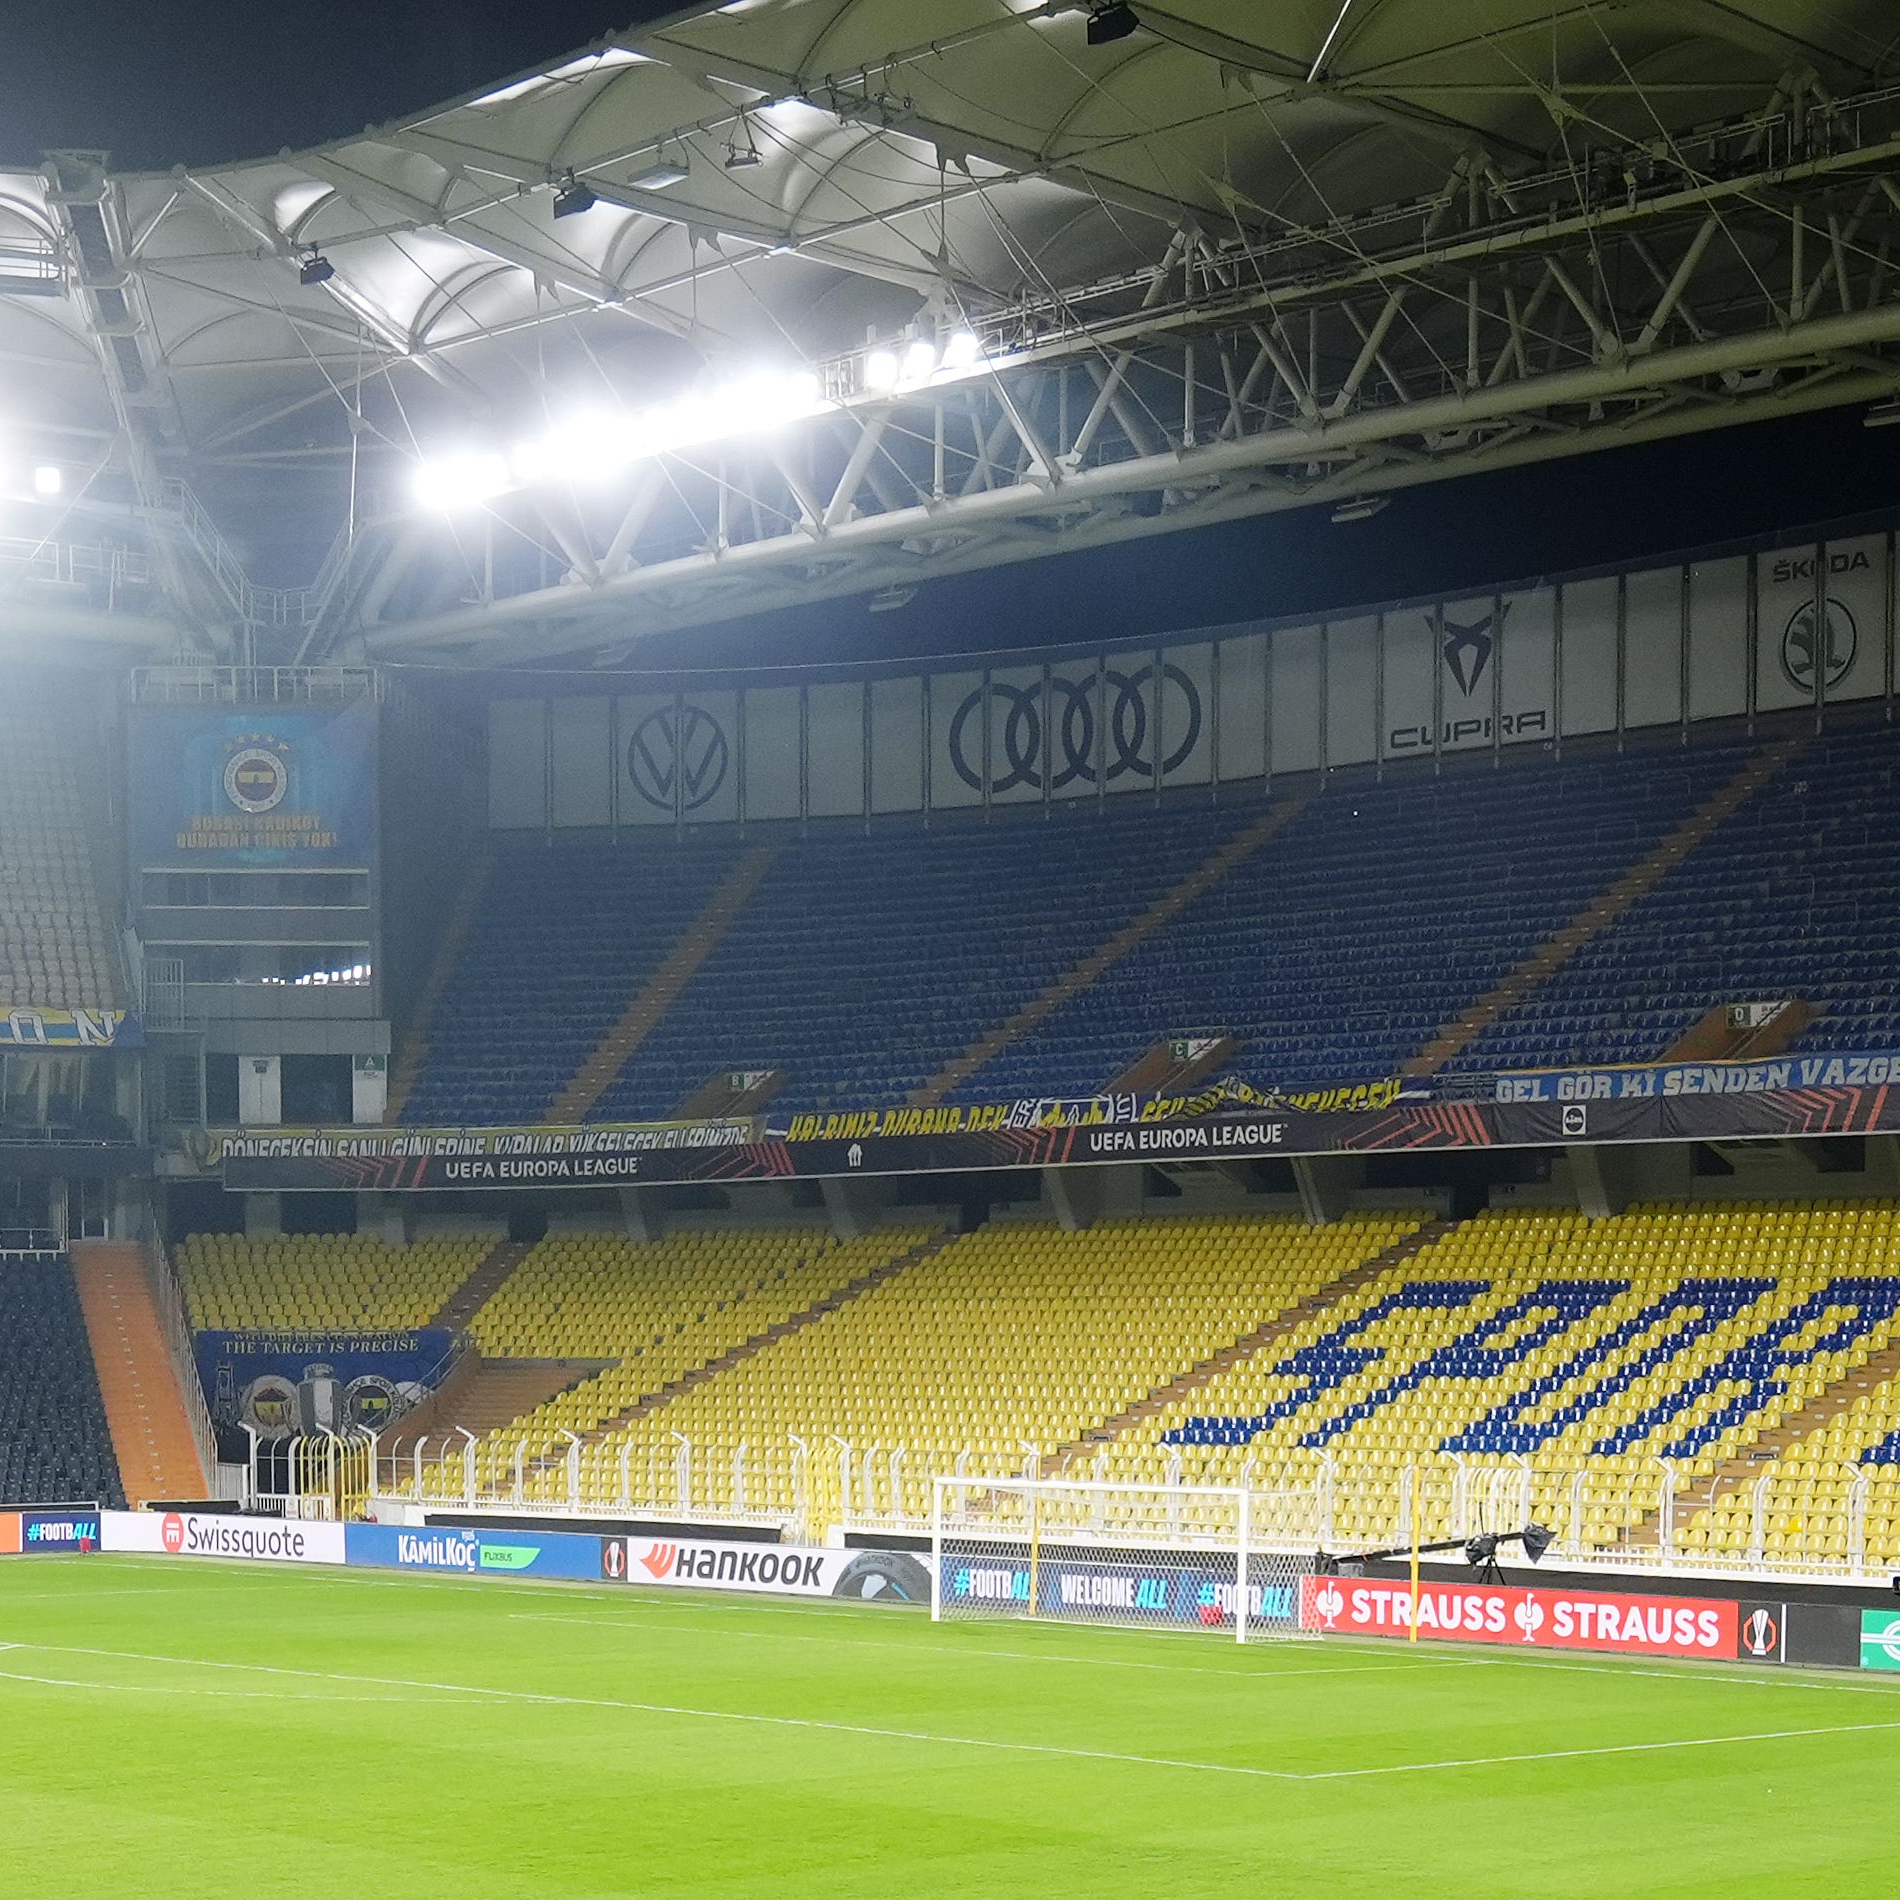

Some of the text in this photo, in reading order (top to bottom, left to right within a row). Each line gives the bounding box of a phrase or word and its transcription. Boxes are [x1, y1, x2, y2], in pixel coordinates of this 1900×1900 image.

[1389, 711, 1547, 750] CUPRA
[1496, 1078, 1552, 1103] GEL
[1557, 1070, 1611, 1102] GÖR
[1619, 1067, 1655, 1098] Kİ
[1662, 1063, 1792, 1096] SENDEN
[1090, 1123, 1283, 1152] UEFA EUROPA LEAGUE
[445, 1156, 638, 1179] UEFA EUROPA LEAGUE
[222, 1338, 420, 1354] THE TARGET IS PRECISE
[26, 1521, 98, 1545] #FOOTBALL
[187, 1515, 304, 1560] Swissquote
[1060, 1574, 1135, 1608] WELCOME
[1135, 1579, 1167, 1610] ALL
[1349, 1589, 1720, 1649] STRAUSS STRAUSS
